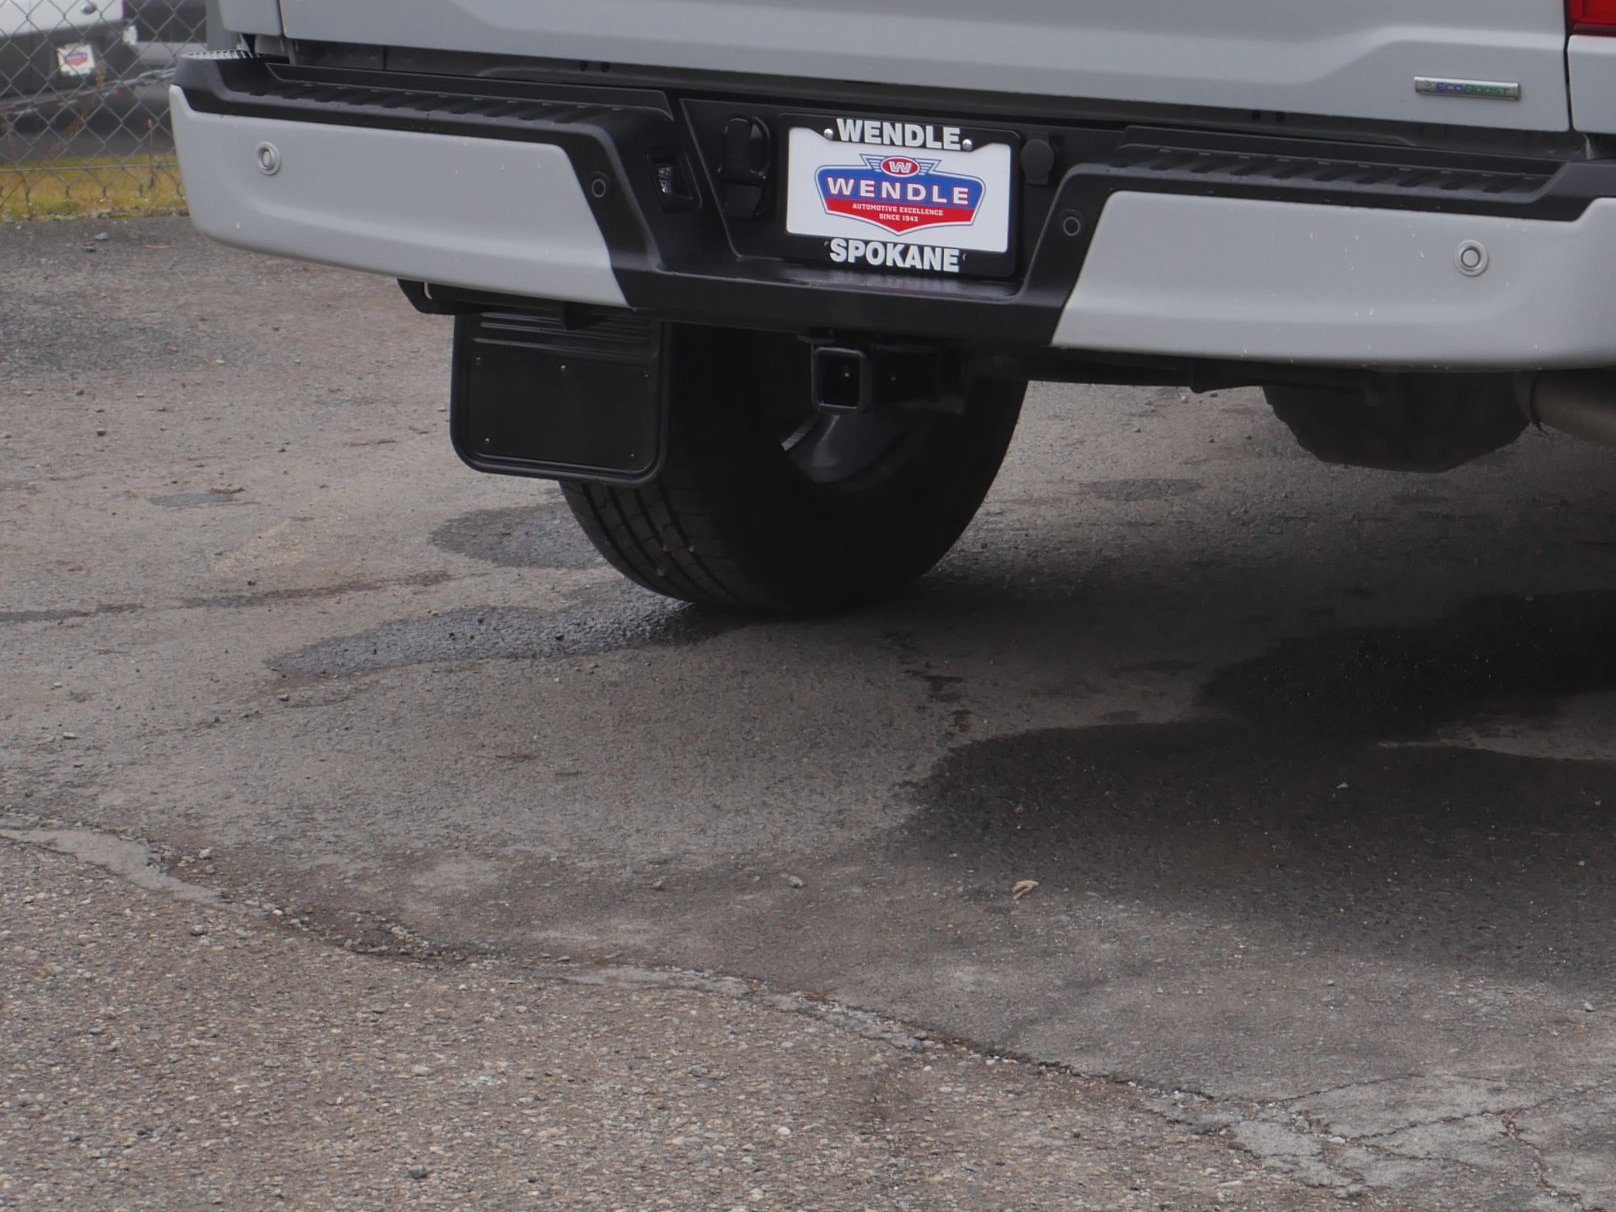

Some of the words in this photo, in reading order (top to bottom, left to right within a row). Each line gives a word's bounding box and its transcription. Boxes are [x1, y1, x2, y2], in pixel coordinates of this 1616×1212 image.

[836, 117, 962, 151] WENDLE
[826, 176, 969, 205] WENDLE
[852, 203, 898, 213] AUTOMOTIVE
[899, 206, 944, 216] EXCELLENCE
[879, 213, 900, 221] SINCE
[829, 238, 961, 273] SPOKANE
